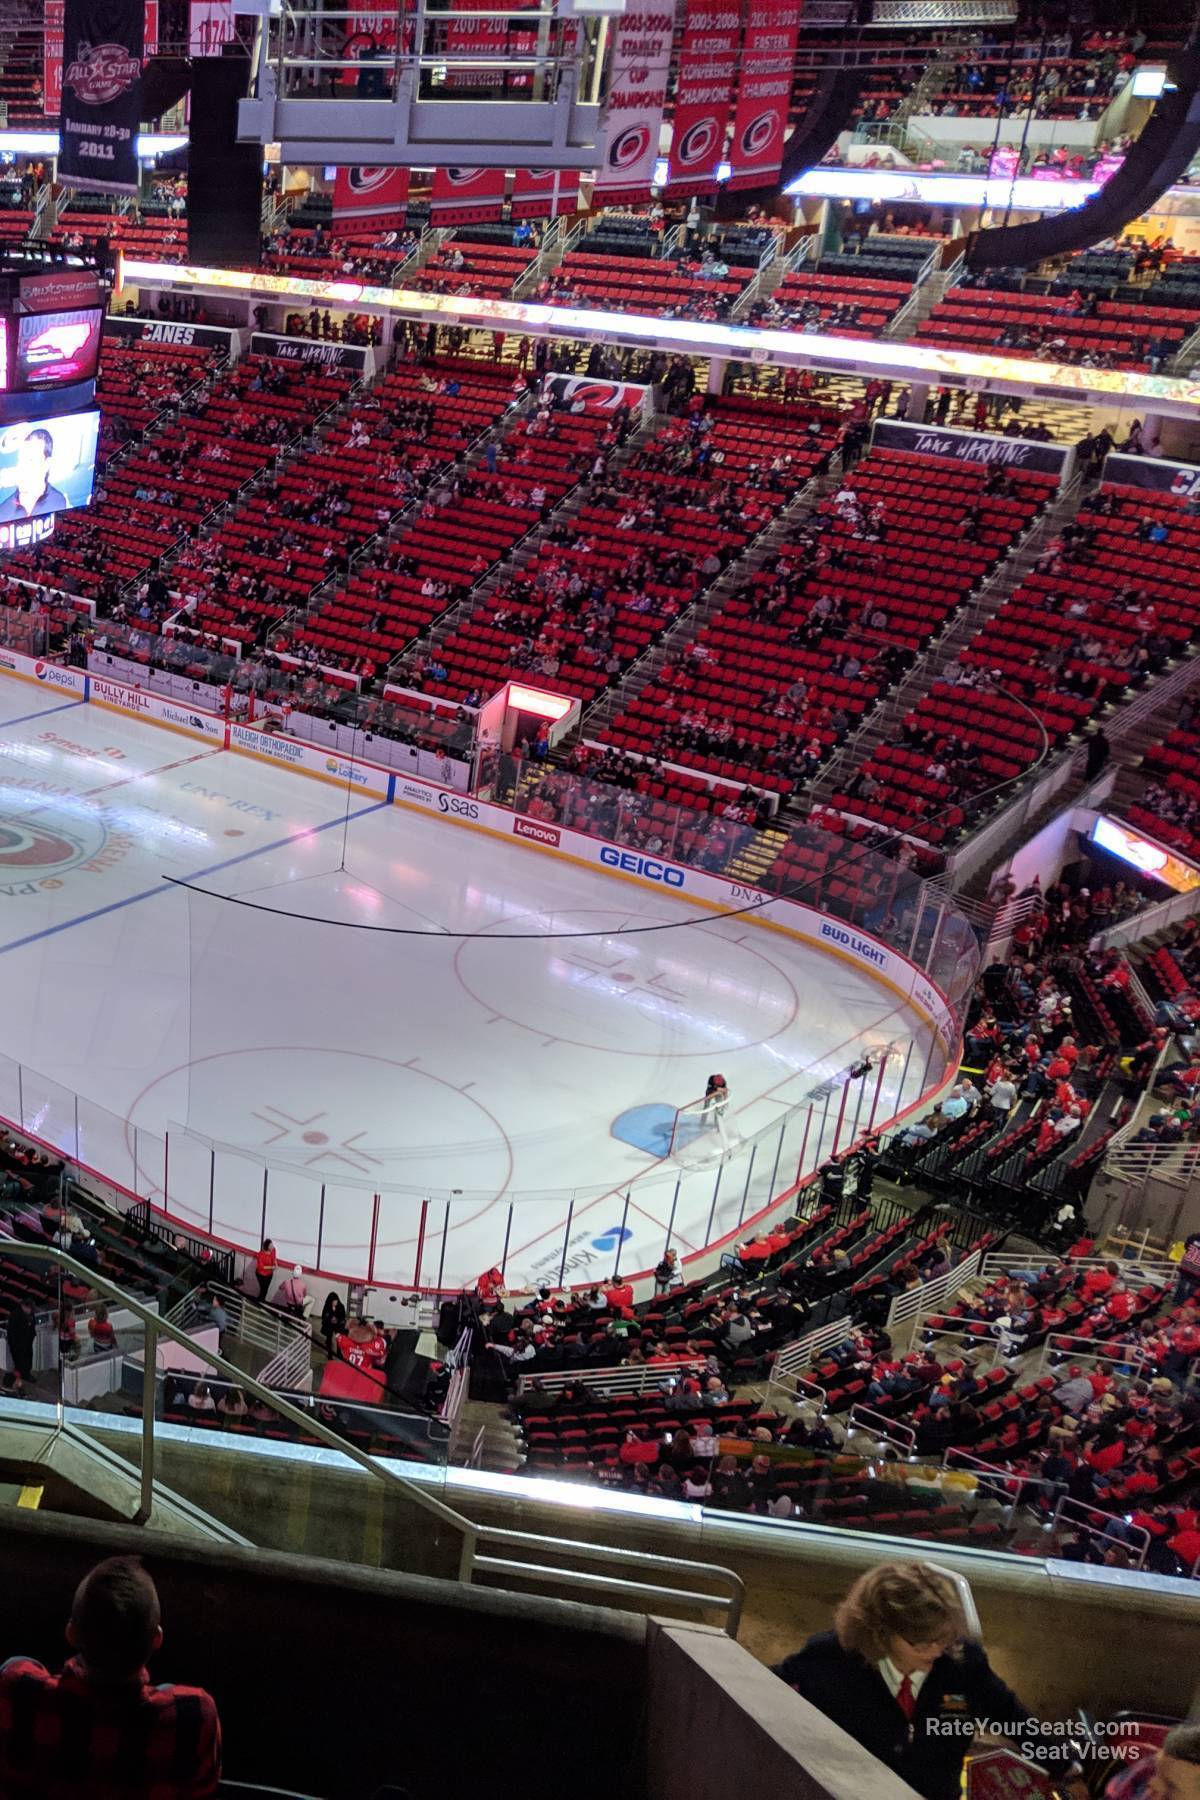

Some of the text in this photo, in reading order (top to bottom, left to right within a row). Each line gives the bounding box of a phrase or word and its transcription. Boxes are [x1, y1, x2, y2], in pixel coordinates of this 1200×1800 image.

[453, 17, 508, 34] 2001-200
[688, 14, 740, 31] 2005-2006
[692, 37, 731, 55] EASTERN
[754, 35, 790, 50] EASTERN
[68, 65, 89, 80] ALL
[107, 64, 139, 79] STAR
[629, 66, 649, 83] CUP
[79, 141, 115, 160] 2011
[141, 323, 195, 345] CANES
[276, 341, 348, 366] TAKE WARNING
[914, 432, 1030, 465] TAKE WARNING
[48, 670, 76, 687] pepsi
[93, 681, 150, 709] BULLY HILL
[103, 695, 141, 712] VINEYARDS
[162, 707, 219, 735] Michael Son
[233, 725, 304, 758] RALEIGH ORTHOPAEDIC
[338, 767, 368, 785] Lottery
[403, 785, 433, 799] ANALYTICS
[517, 821, 557, 843] Lenovo
[600, 846, 685, 888] GEICO
[730, 884, 764, 905] DNA
[821, 923, 887, 966] BUD LIGHT
